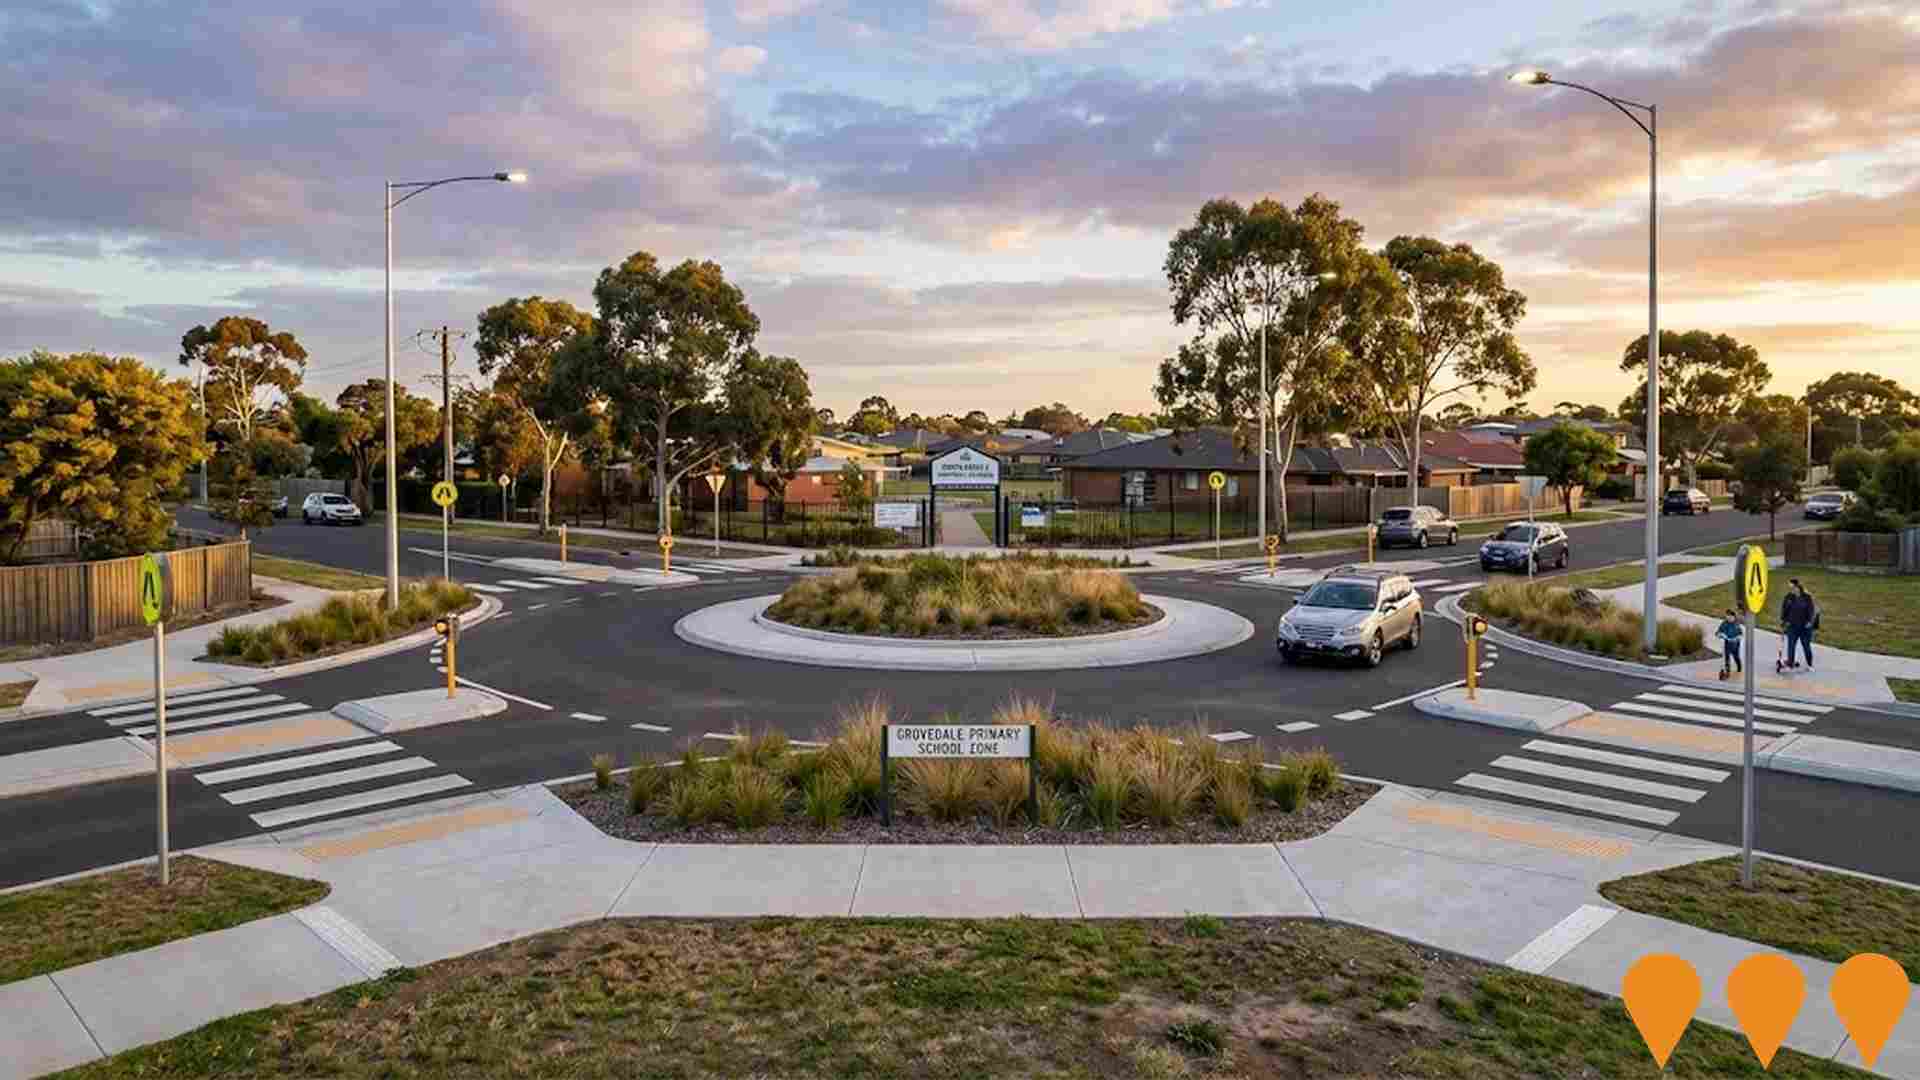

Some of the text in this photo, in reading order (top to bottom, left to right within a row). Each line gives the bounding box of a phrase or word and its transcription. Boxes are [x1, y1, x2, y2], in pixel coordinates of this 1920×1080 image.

[896, 727, 1021, 741] GROVEDALE PRIMARY
[917, 742, 1000, 755] SCHOOL ZONE
